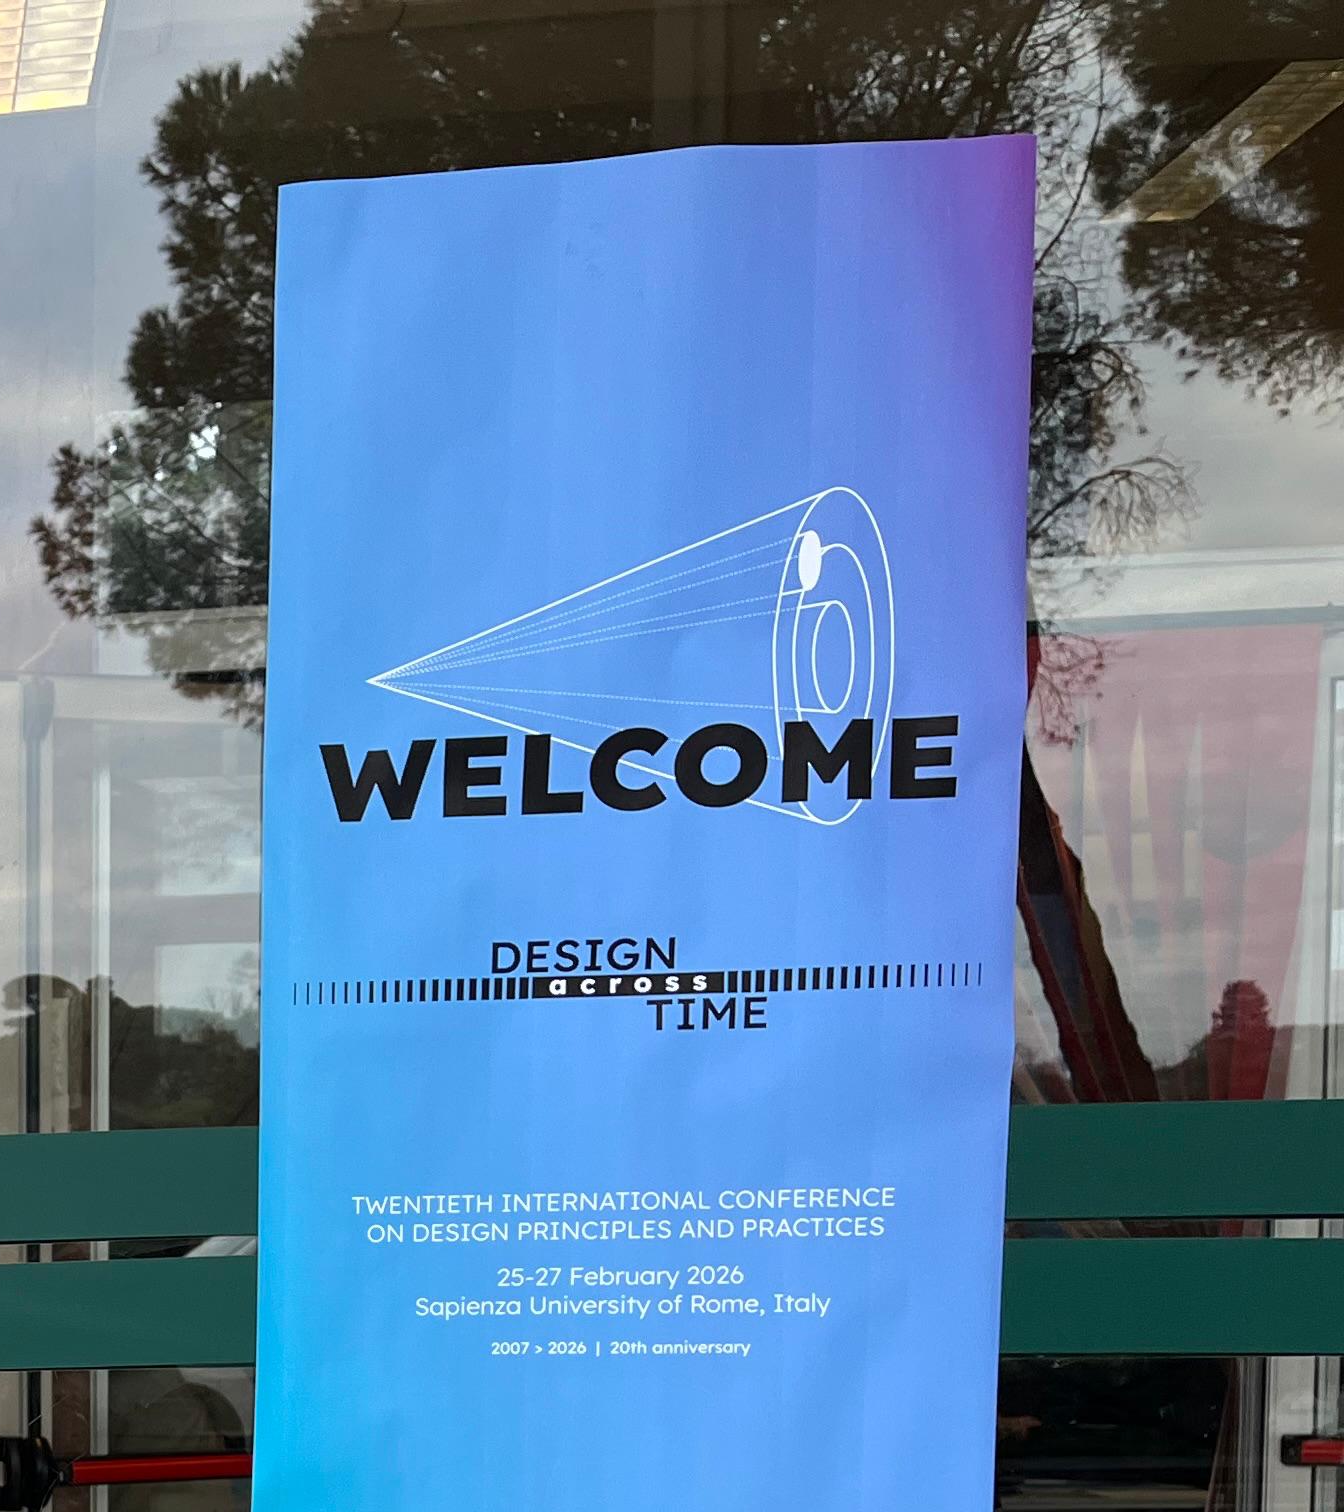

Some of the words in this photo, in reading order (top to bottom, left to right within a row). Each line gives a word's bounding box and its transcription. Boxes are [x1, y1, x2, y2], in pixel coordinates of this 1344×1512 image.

[319, 715, 960, 823] WELCOME
[491, 936, 676, 974] DESIGN
[548, 974, 707, 996] across
[646, 996, 768, 1031] TIME
[351, 1194, 493, 1216] TWENTIETH
[502, 1190, 711, 1213] INTERNATIONAL
[718, 1187, 896, 1210] CONFERENCE
[367, 1224, 404, 1243] ON
[413, 1222, 509, 1243] DESIGN
[518, 1219, 672, 1241] PRINCIPLES
[679, 1218, 735, 1239] AND
[743, 1216, 885, 1238] PRACTICES
[496, 1267, 562, 1288] 25-27
[570, 1265, 680, 1291] February
[686, 1265, 745, 1286] 2026
[415, 1296, 521, 1321] Sapienza
[530, 1294, 651, 1320] University
[657, 1294, 683, 1315] of
[690, 1294, 766, 1317] Rome,
[773, 1292, 831, 1318] Italy
[491, 1341, 530, 1356] 2007
[547, 1341, 587, 1355] 2026
[610, 1340, 647, 1355] 20th
[652, 1340, 751, 1357] anniversary
